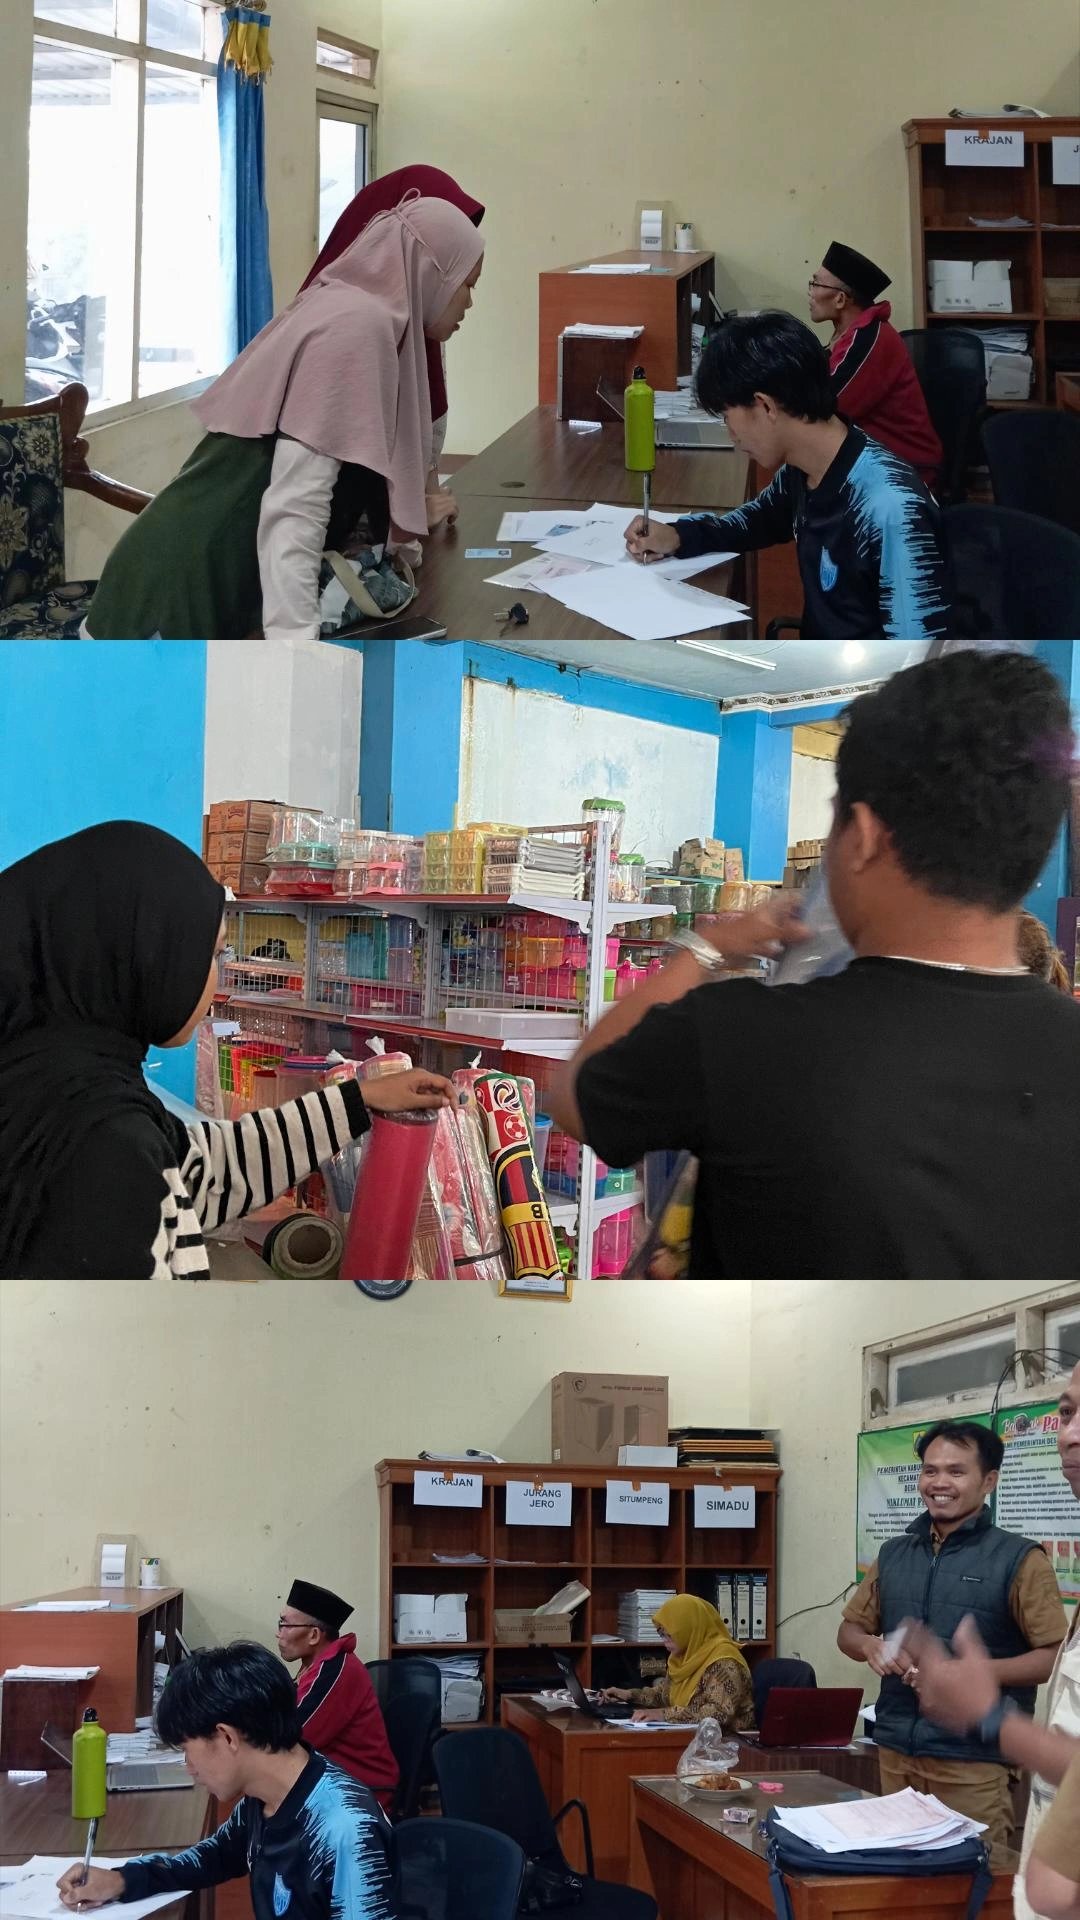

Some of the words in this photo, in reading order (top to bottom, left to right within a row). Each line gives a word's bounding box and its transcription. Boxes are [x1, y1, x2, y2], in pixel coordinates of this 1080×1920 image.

[964, 135, 1013, 145] KRAJAN
[877, 1465, 907, 1474] PEMERINTAH
[907, 1464, 922, 1472] KABU
[431, 1477, 474, 1487] KRAJAN
[523, 1488, 562, 1498] JURANG
[529, 1499, 555, 1508] JERO
[618, 1495, 663, 1505] SITUMPENG
[706, 1501, 750, 1511] SIMADU
